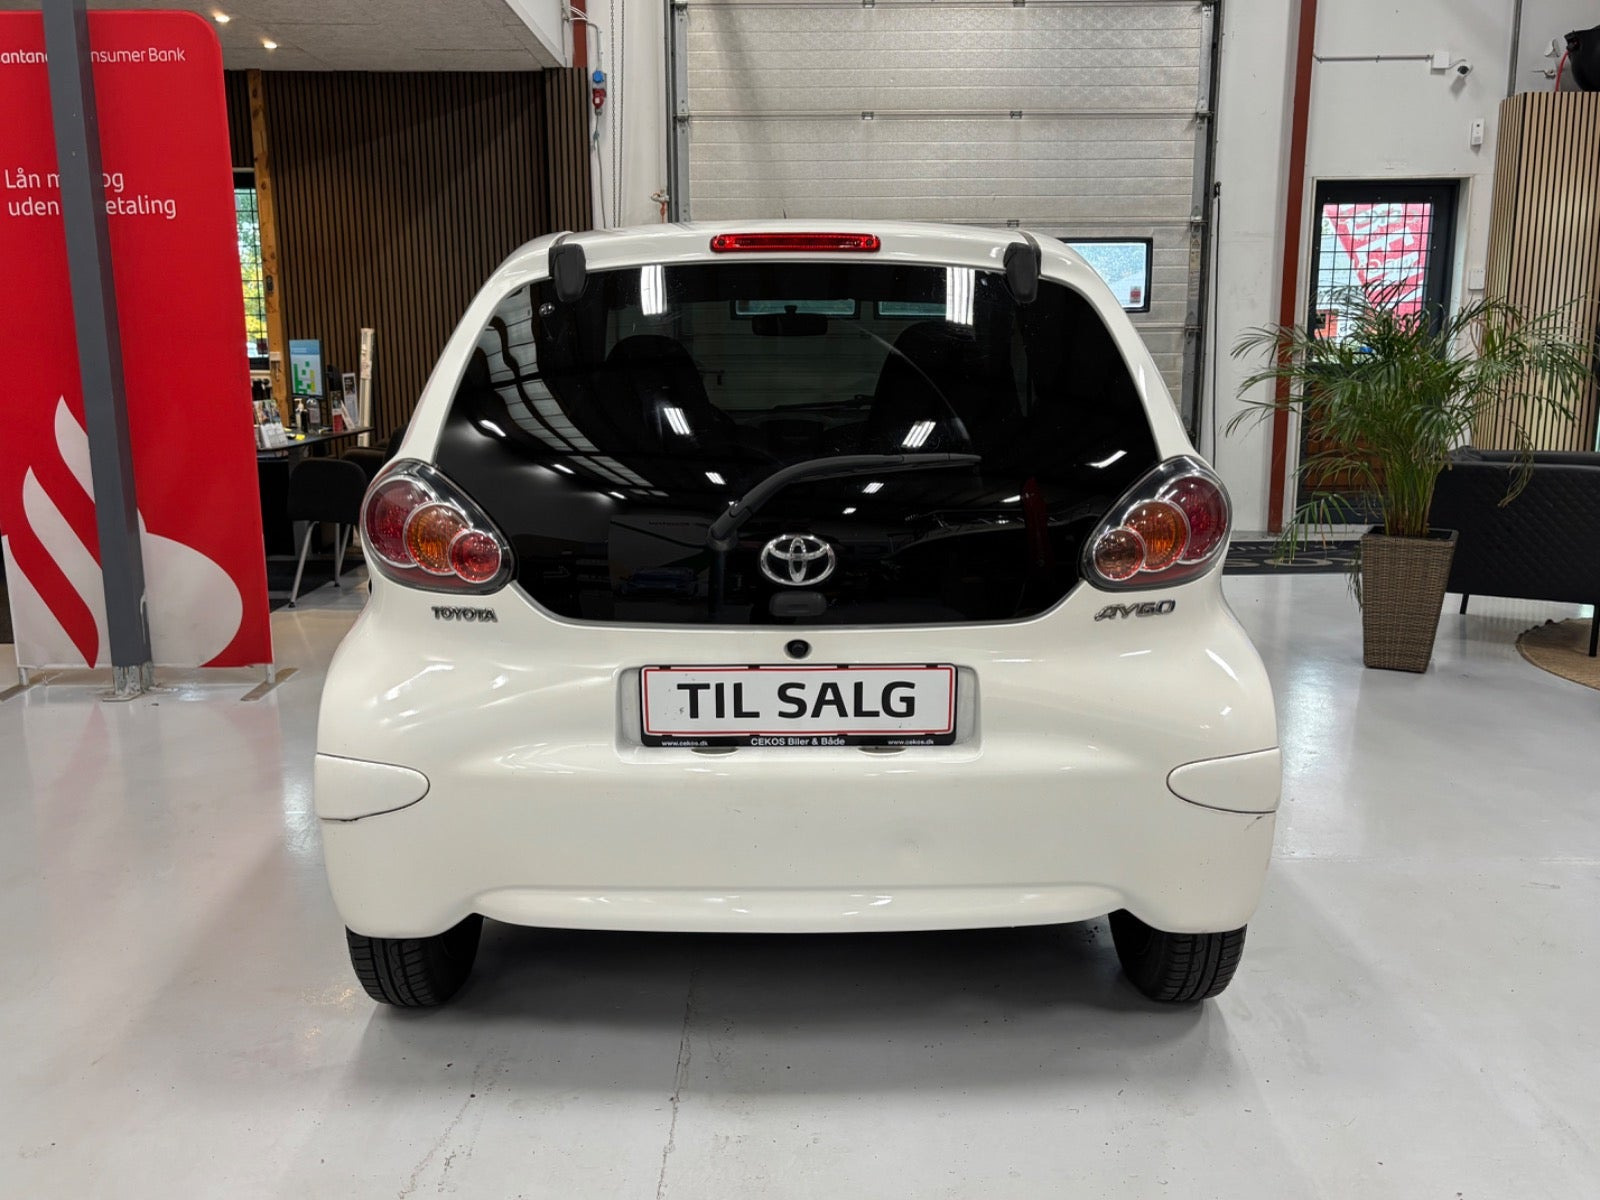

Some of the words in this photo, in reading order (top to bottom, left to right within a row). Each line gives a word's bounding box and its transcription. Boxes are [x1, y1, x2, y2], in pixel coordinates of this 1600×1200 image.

[0, 49, 48, 64] antan
[91, 50, 146, 63] nsumer
[148, 47, 186, 62] Bank
[5, 167, 41, 189] Lån
[8, 196, 60, 216] uden
[105, 194, 176, 219] etaling
[431, 606, 498, 622] TOYOTA
[1094, 599, 1176, 622] AYGO
[677, 682, 760, 719] TIL
[777, 681, 916, 719] SALG
[661, 739, 709, 747] www.cekos.dk
[750, 736, 786, 747] CEKOS
[787, 736, 809, 747] Biler
[811, 737, 820, 747] &
[821, 736, 846, 747] Både
[887, 738, 935, 746] www.cekos.dk
